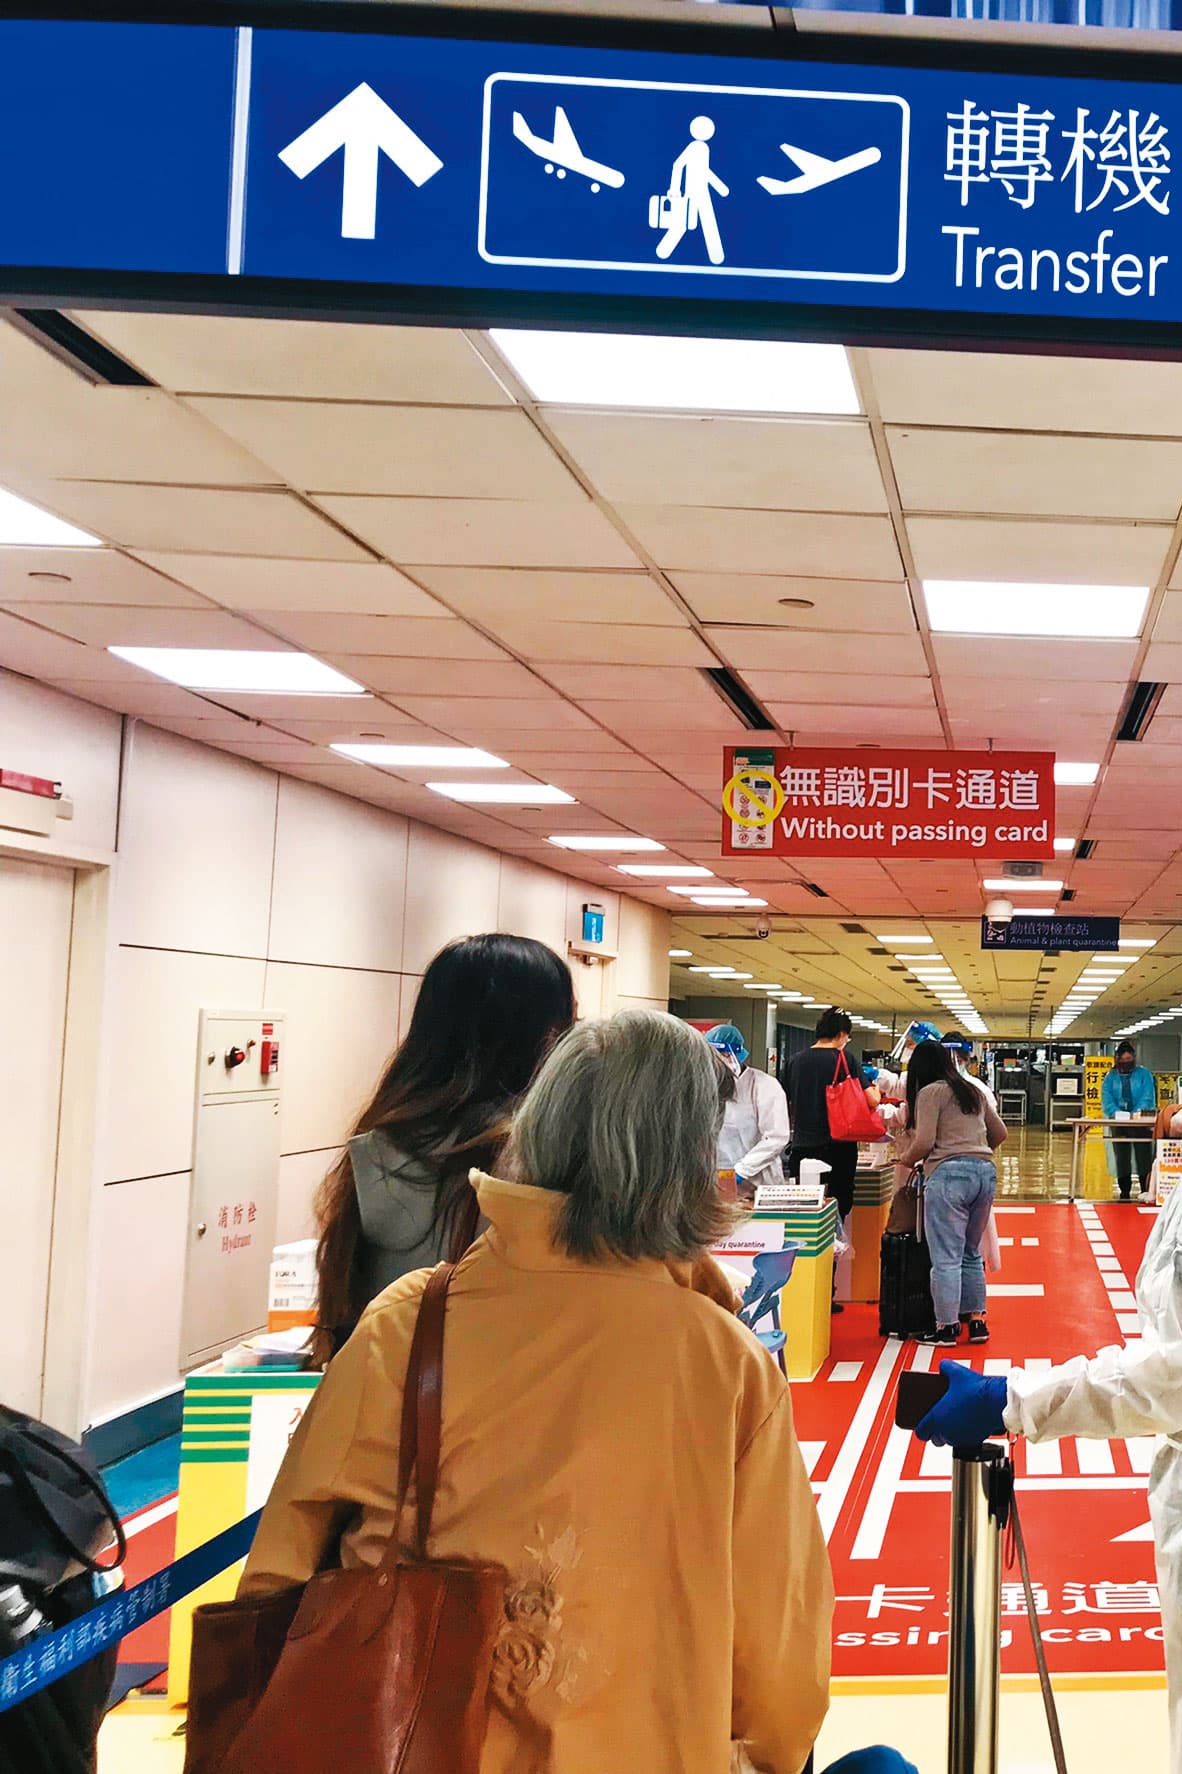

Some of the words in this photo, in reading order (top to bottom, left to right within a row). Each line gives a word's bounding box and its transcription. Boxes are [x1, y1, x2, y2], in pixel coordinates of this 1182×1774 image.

[943, 99, 1172, 215] 轉機
[942, 225, 1169, 297] Transfer
[779, 765, 1040, 811] 無識別卡通道
[781, 816, 885, 840] Without
[891, 819, 988, 847] passing
[994, 821, 1048, 843] card
[1010, 936, 1039, 945] Animal
[1041, 937, 1047, 945] &
[1050, 937, 1071, 946] plant
[1072, 938, 1117, 947] quarantine
[728, 1240, 766, 1249] quarantine
